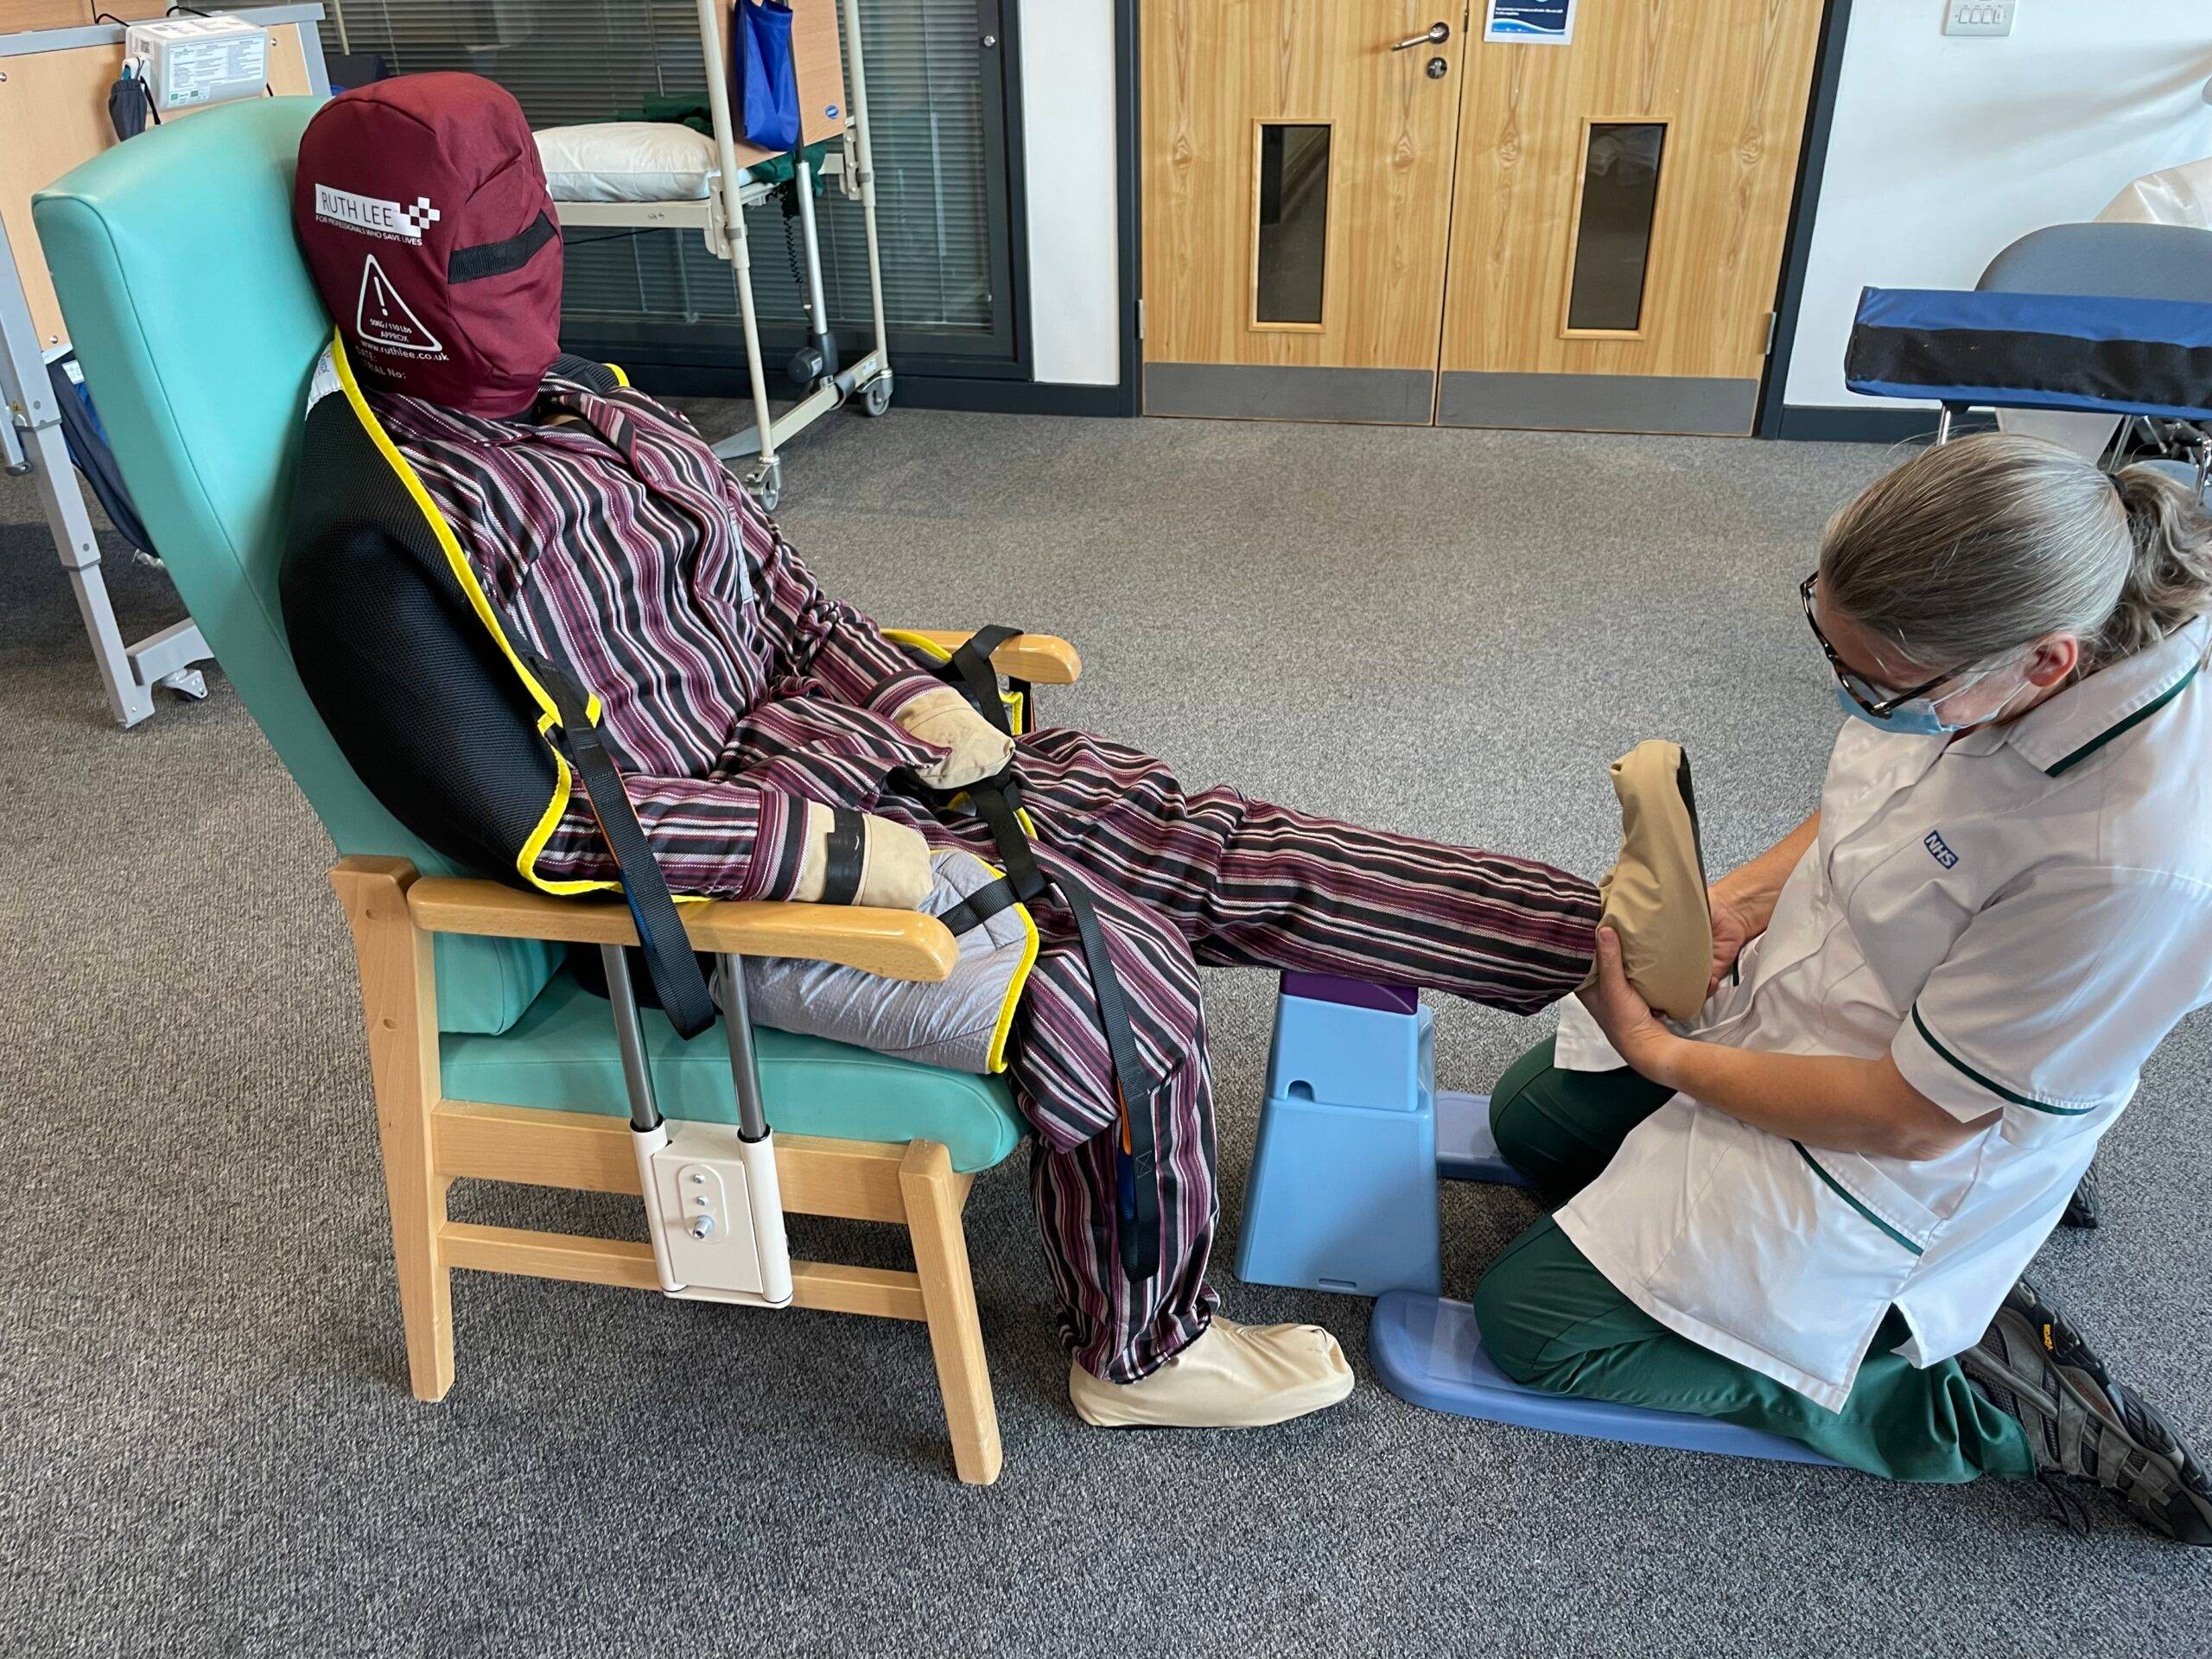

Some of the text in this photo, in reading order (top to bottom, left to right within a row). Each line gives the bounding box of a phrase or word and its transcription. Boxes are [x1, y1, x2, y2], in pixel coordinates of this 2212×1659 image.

[321, 192, 393, 227] RUTH LEE
[327, 217, 366, 235] PROFESSIONALS
[366, 228, 382, 238] WHO
[383, 231, 402, 242] SAVE
[402, 235, 423, 246] LIVES
[360, 340, 449, 360] www.ruthlee.co.uk
[1925, 834, 1955, 867] NHS
